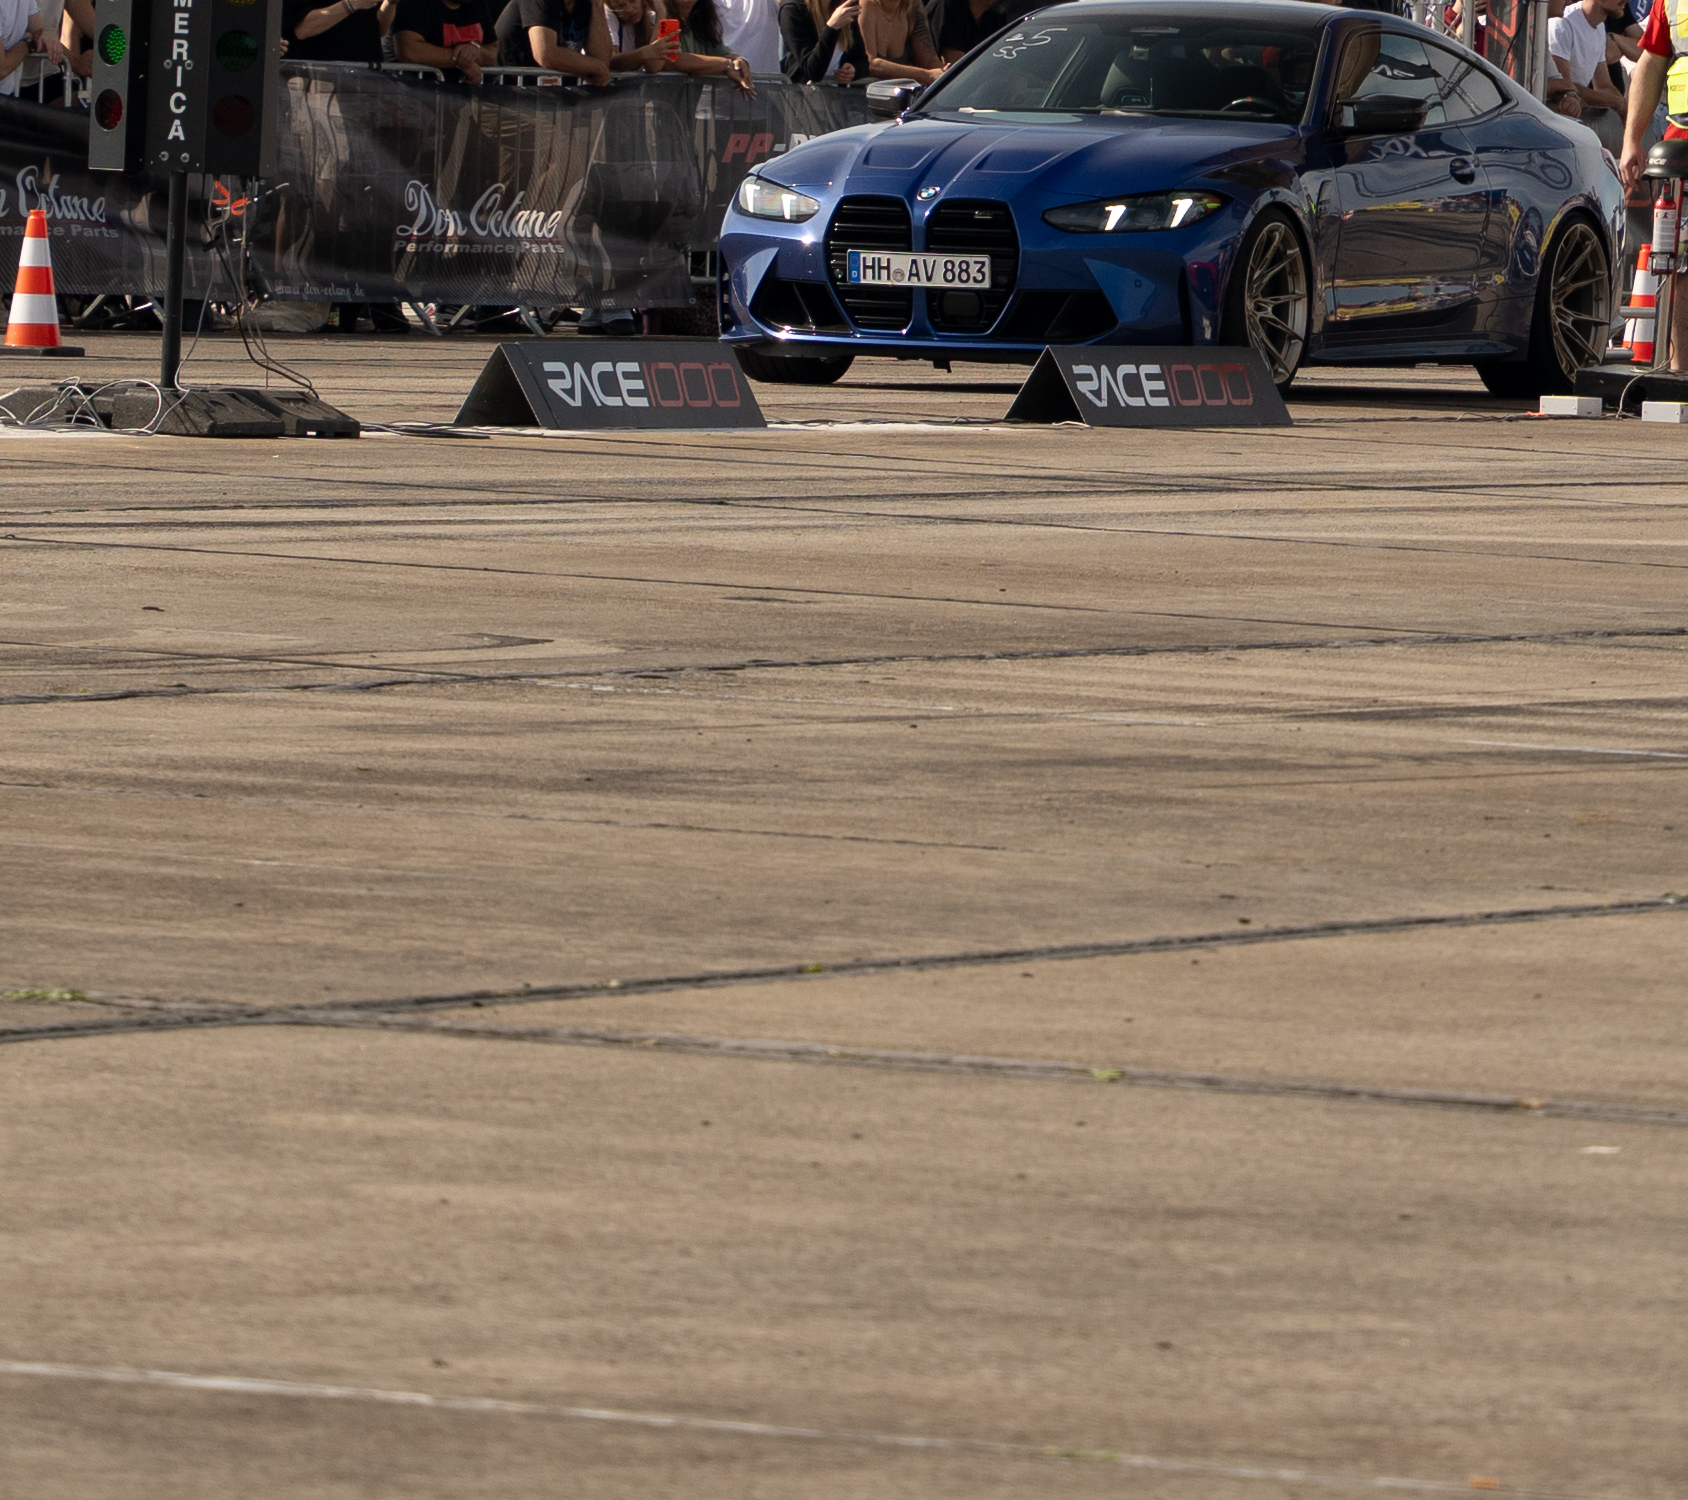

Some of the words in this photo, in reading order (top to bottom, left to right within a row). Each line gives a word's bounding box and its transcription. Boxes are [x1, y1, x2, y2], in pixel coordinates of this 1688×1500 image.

[71, 224, 119, 238] Parts
[394, 240, 515, 254] Performance
[521, 240, 565, 254] Parts
[862, 256, 891, 281] HH
[907, 258, 937, 283] AV
[942, 259, 986, 284] 883
[542, 361, 741, 407] RACE1000
[1071, 364, 1253, 407] RACE1000
